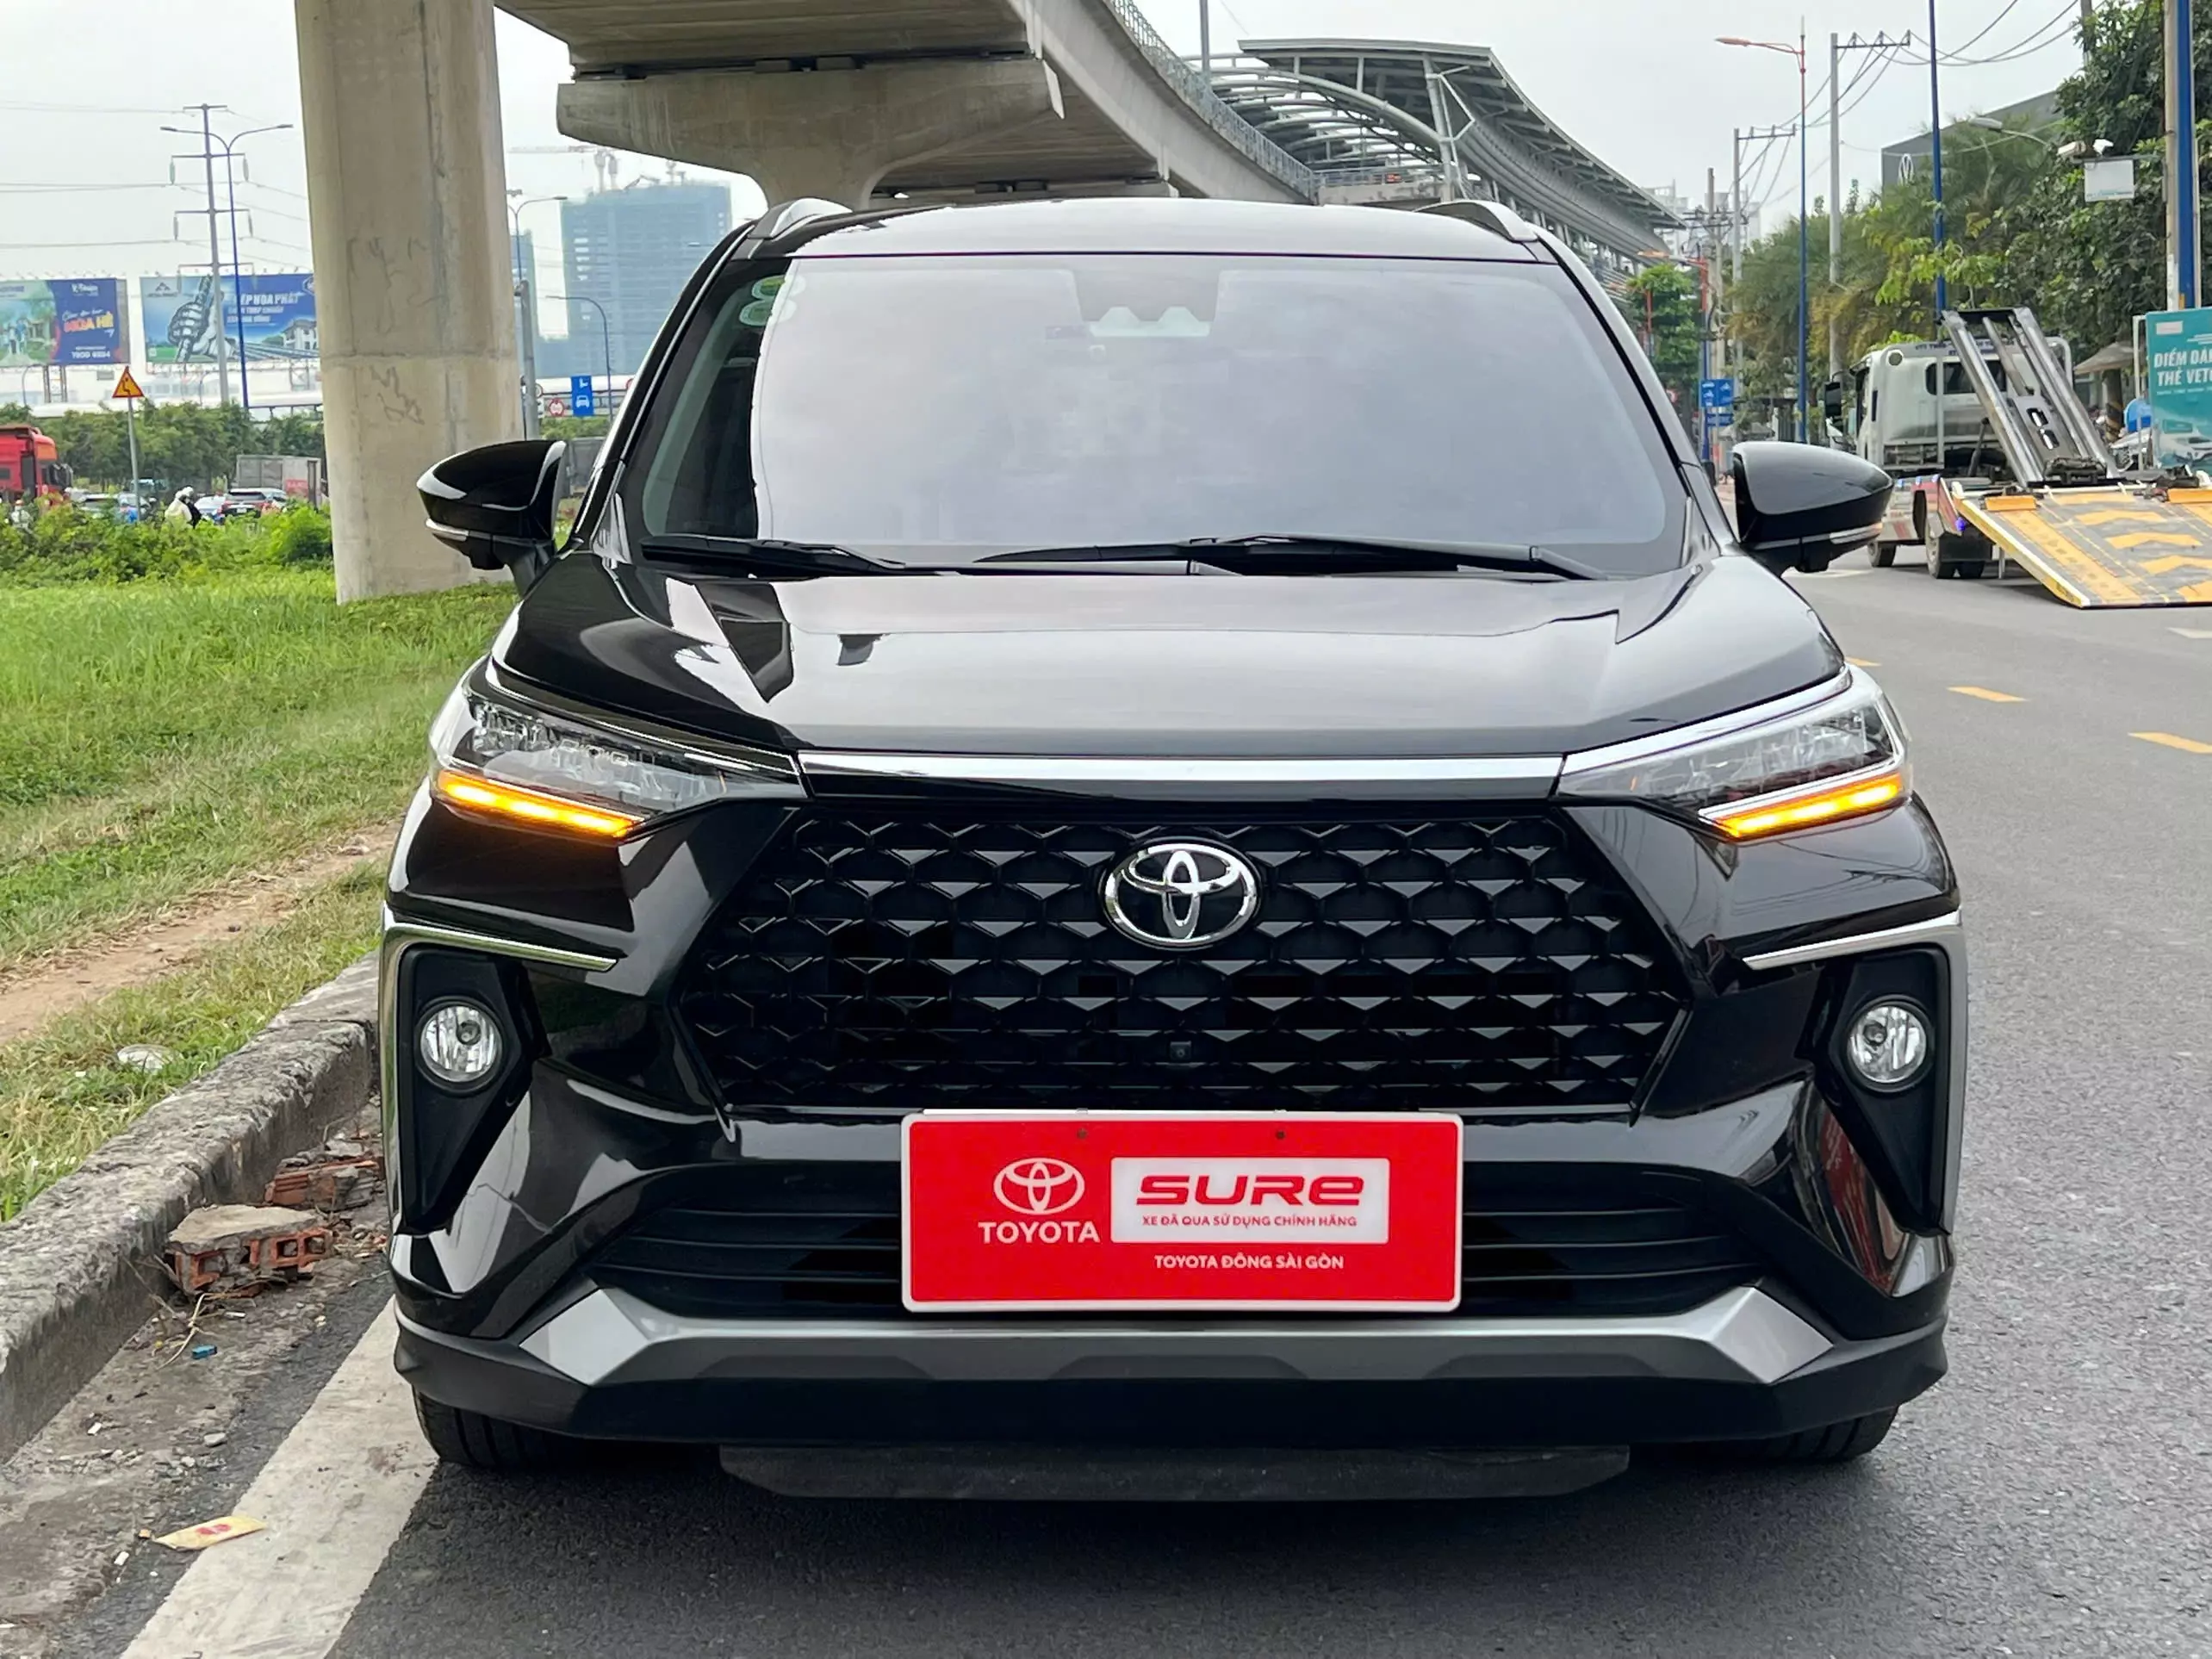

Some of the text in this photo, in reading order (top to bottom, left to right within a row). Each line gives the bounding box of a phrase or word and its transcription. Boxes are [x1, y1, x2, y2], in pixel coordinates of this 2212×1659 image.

[1142, 1216, 1158, 1226] XE
[1161, 1215, 1178, 1226] ĐÃ
[1182, 1216, 1210, 1226] QUA
[1214, 1214, 1230, 1226] SỬ
[1233, 1216, 1271, 1228] DỤNG
[1274, 1215, 1315, 1226] CHÍNH
[979, 1221, 1100, 1245] TOYOTA
[1154, 1252, 1345, 1269] TOYOTA ĐÔNG SÀI GÒN
